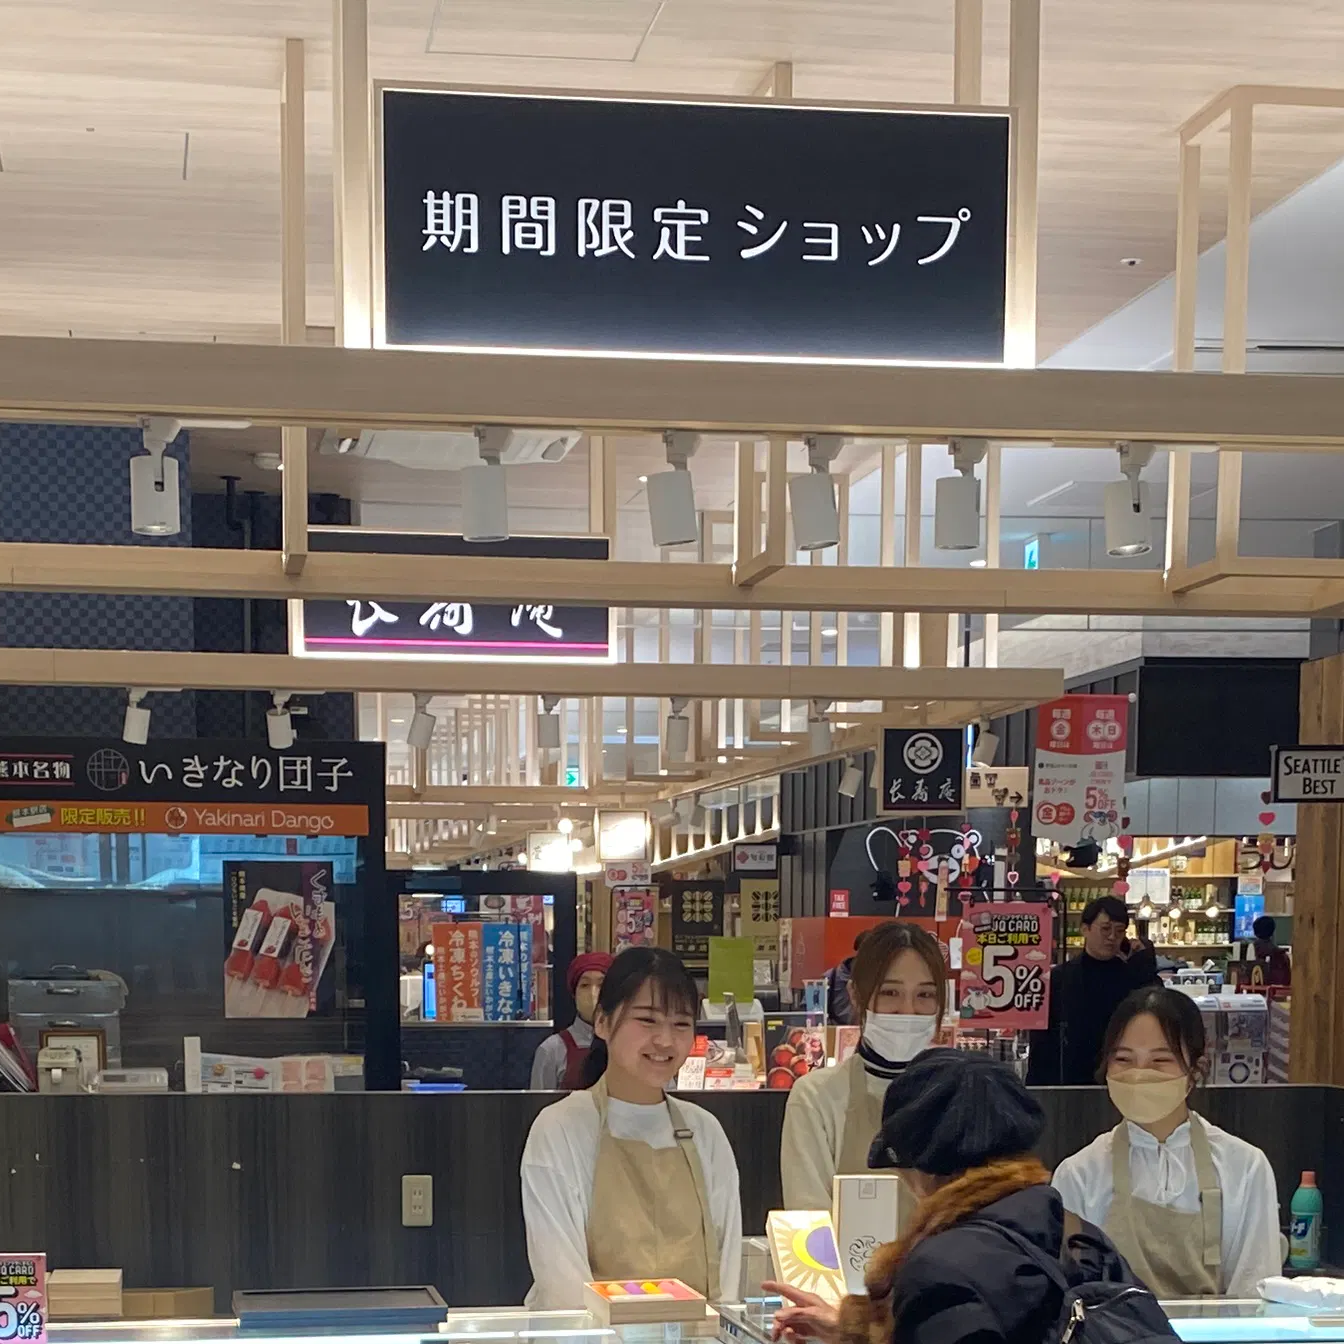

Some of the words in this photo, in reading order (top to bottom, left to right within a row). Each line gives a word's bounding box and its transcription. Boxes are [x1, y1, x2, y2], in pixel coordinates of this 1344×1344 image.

[421, 190, 972, 267] 期間限定ショップ
[138, 755, 354, 793] いきなり団子
[1302, 776, 1337, 795] BEST
[193, 808, 266, 828] Yakinari
[270, 811, 334, 830] Dango
[1008, 921, 1039, 932] CARD
[1015, 994, 1041, 1008] OFF
[9, 1265, 35, 1276] CARD
[17, 1324, 41, 1338] OFF
